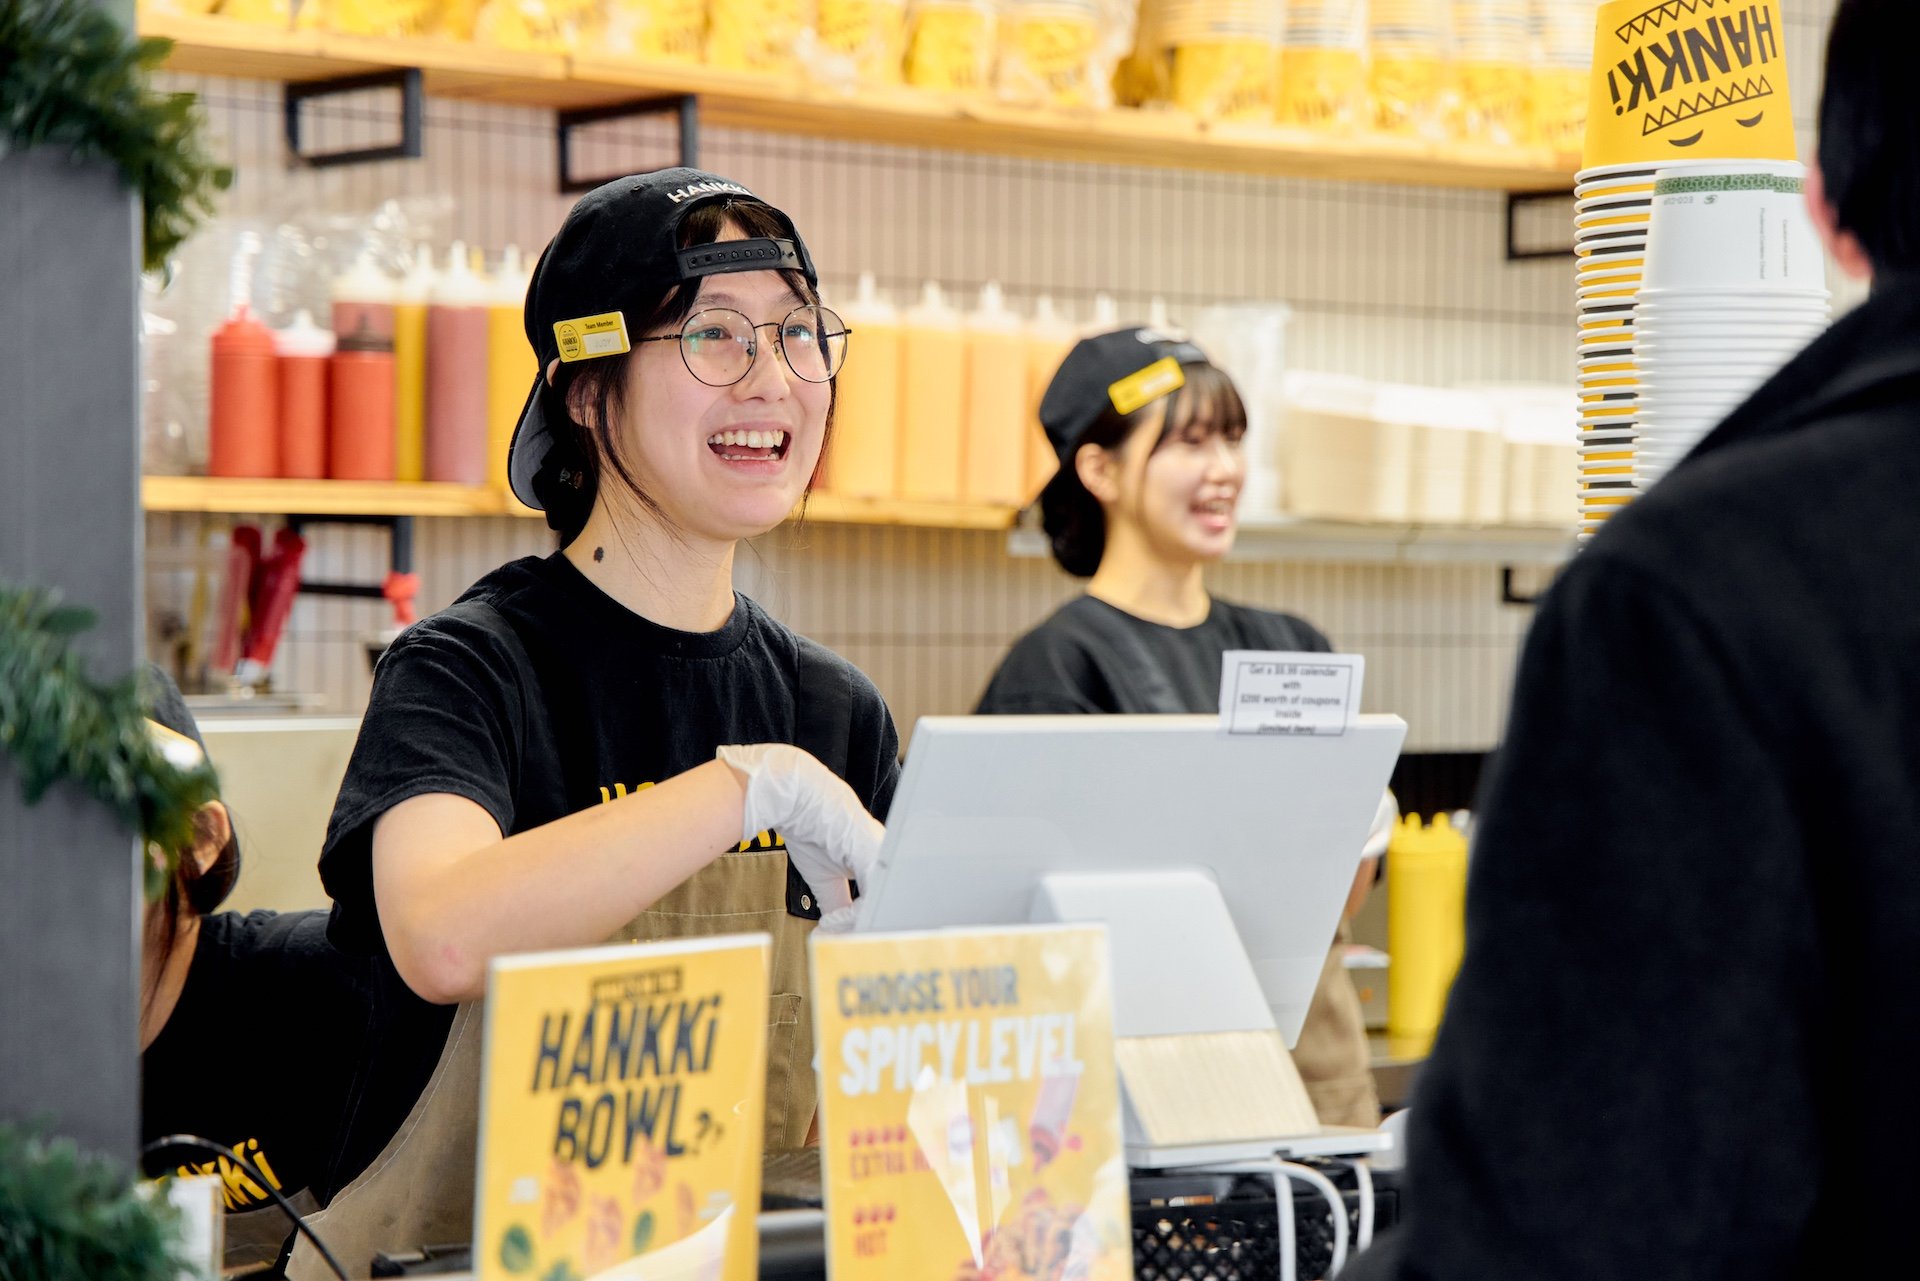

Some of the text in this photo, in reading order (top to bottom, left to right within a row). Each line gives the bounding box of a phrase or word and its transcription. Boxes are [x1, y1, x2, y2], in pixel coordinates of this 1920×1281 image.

[585, 320, 614, 330] Team Member
[1248, 663, 1264, 675] Get
[1282, 681, 1301, 690] with
[1264, 695, 1289, 704] worth
[1291, 696, 1300, 704] of
[838, 966, 1019, 1018] CHOOSE YOUR
[838, 1012, 1085, 1097] SPICY LEVEL
